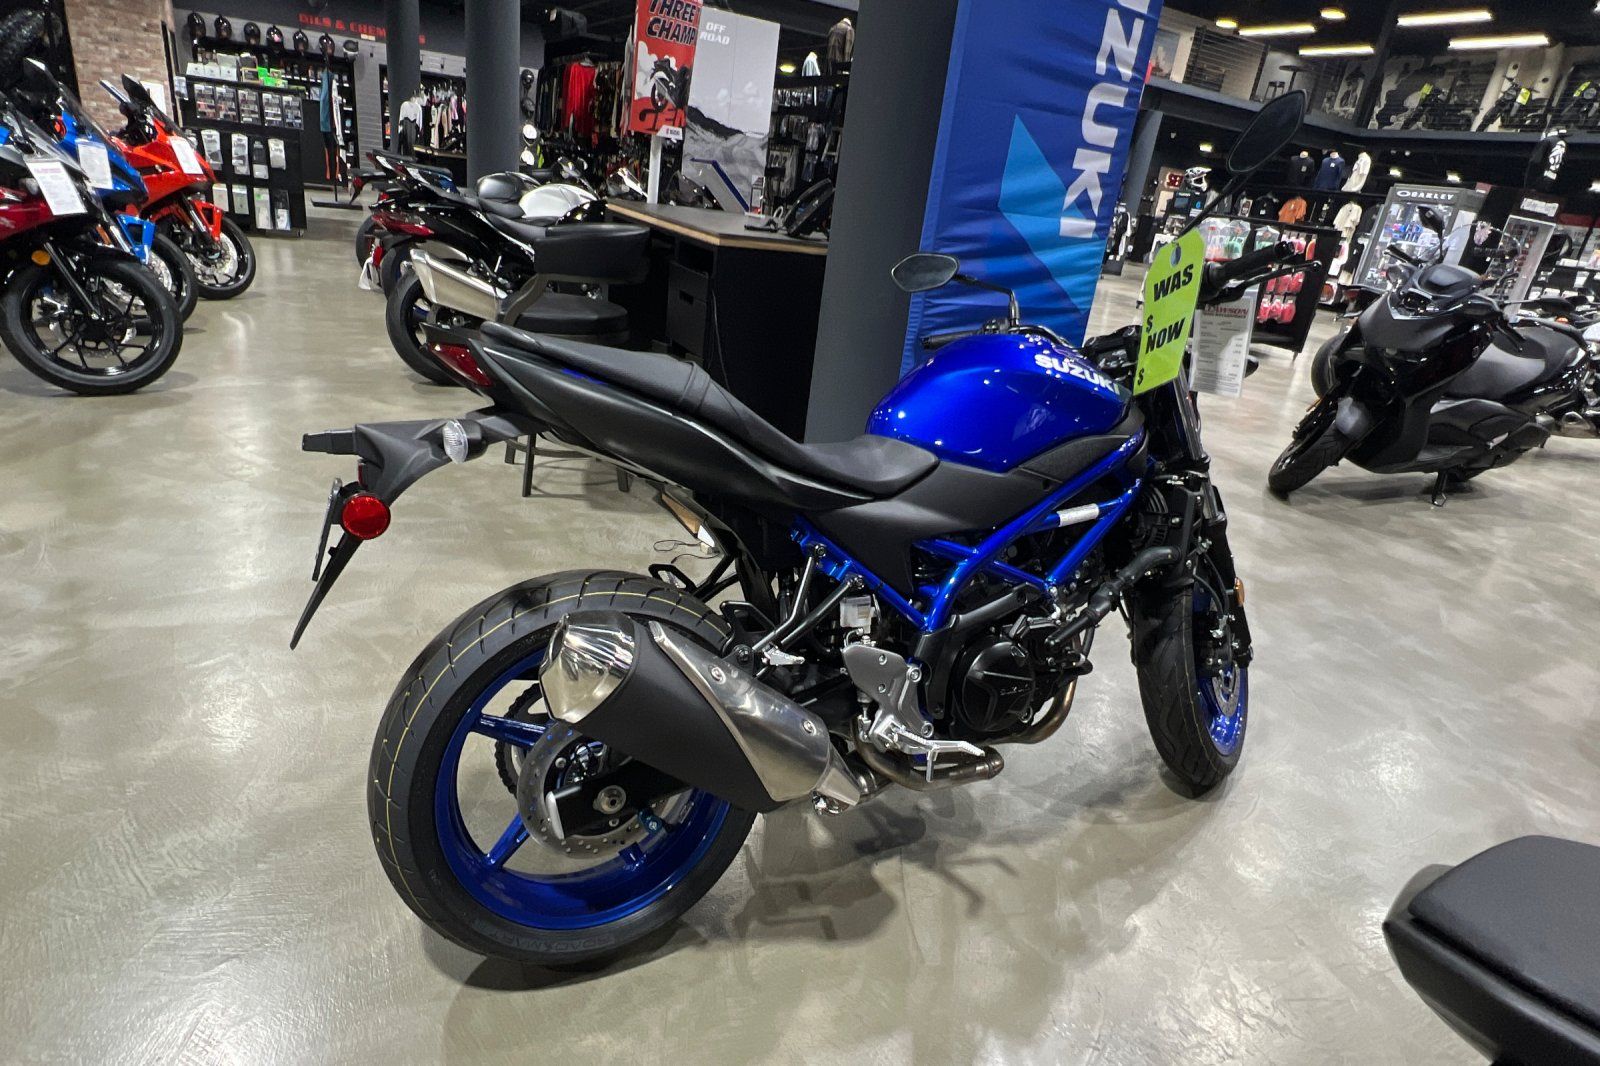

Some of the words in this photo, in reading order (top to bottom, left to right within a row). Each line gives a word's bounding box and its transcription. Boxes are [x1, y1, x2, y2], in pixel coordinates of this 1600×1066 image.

[648, 0, 698, 24] THREE
[647, 17, 697, 46] CHAMP
[699, 31, 731, 45] ROAD
[705, 22, 727, 33] OFF
[1153, 263, 1194, 302] WAS
[1146, 314, 1154, 333] $
[1145, 317, 1186, 355] NOW
[1034, 353, 1121, 396] SUZUKI
[1137, 367, 1145, 386] $
